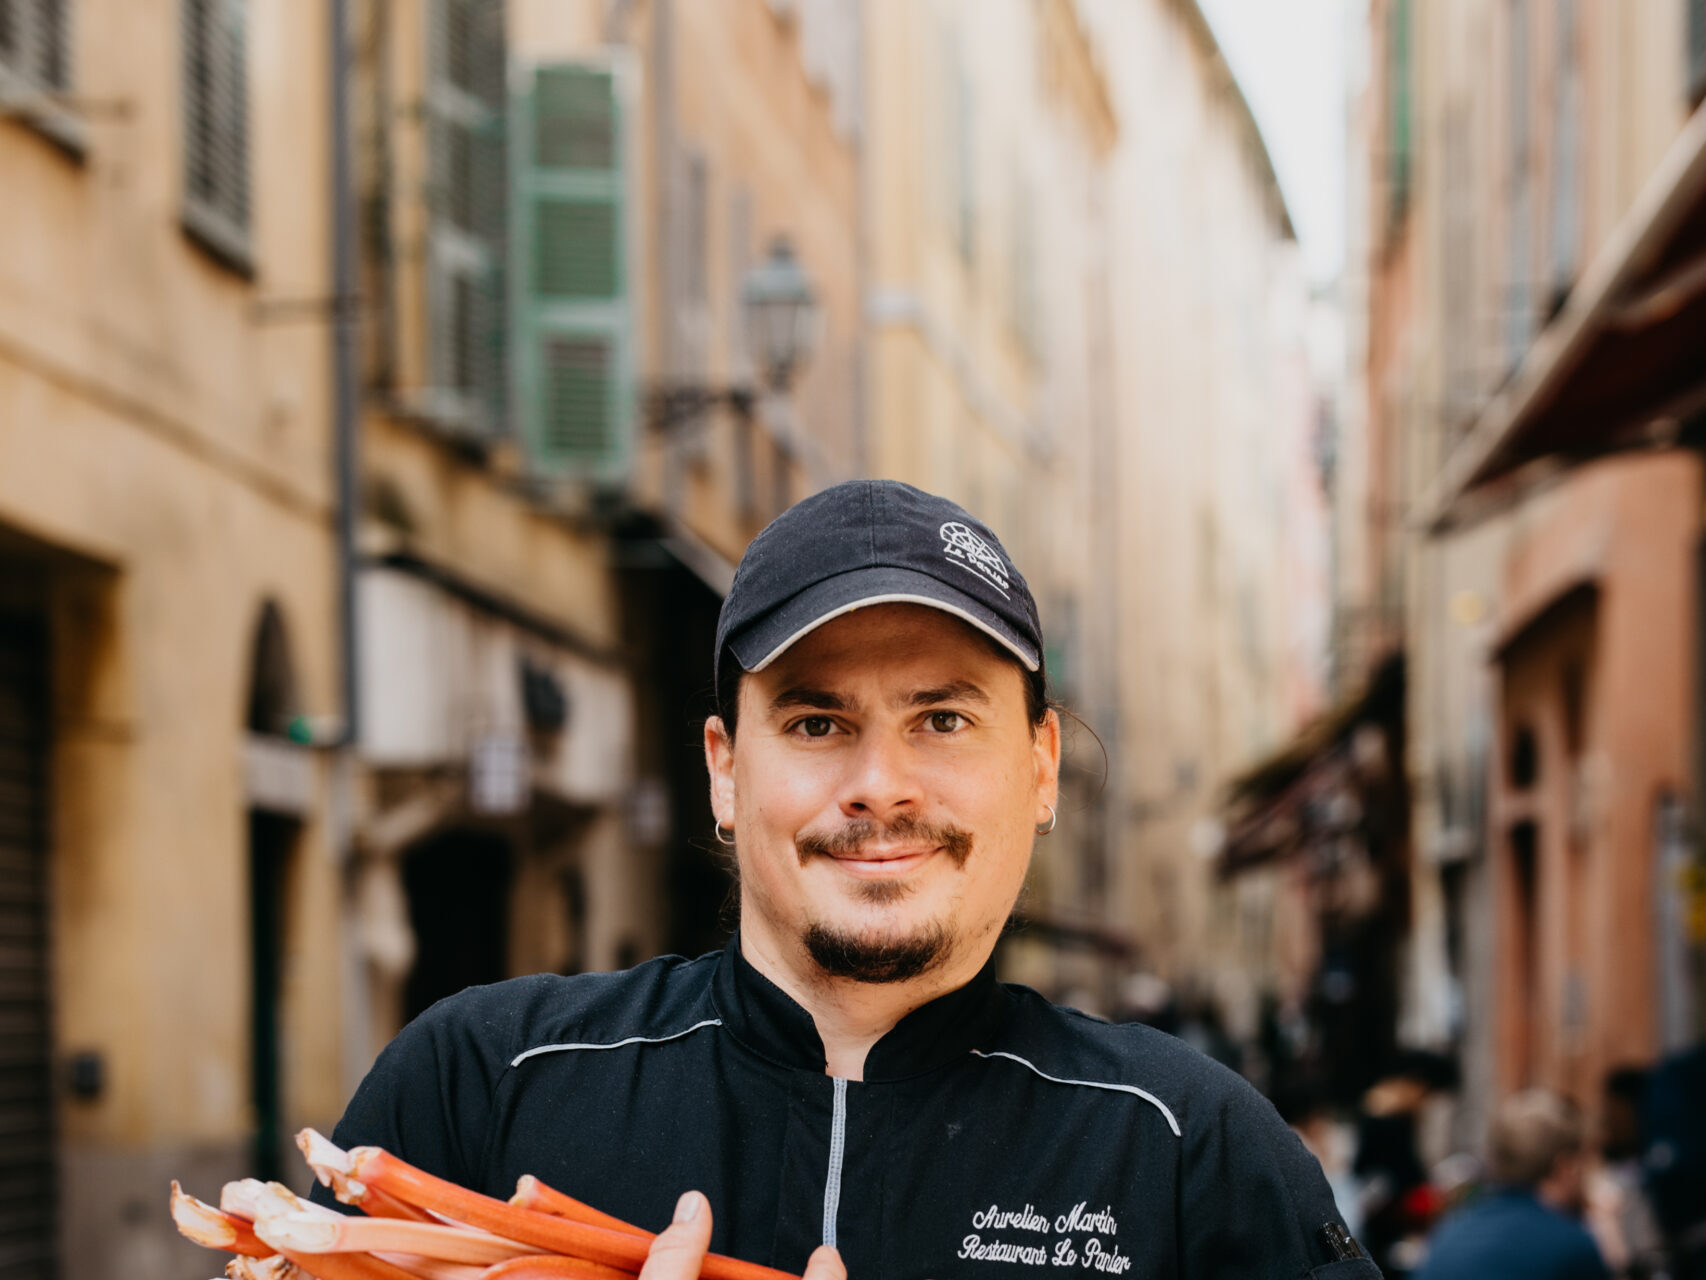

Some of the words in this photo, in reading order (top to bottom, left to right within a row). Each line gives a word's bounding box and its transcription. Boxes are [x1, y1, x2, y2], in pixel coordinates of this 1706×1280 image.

[972, 1203, 1050, 1234] Aurelien
[1054, 1201, 1117, 1235] Martin
[957, 1234, 1048, 1265] Restaurant
[1052, 1238, 1078, 1266] Le
[1081, 1238, 1132, 1275] Panier
